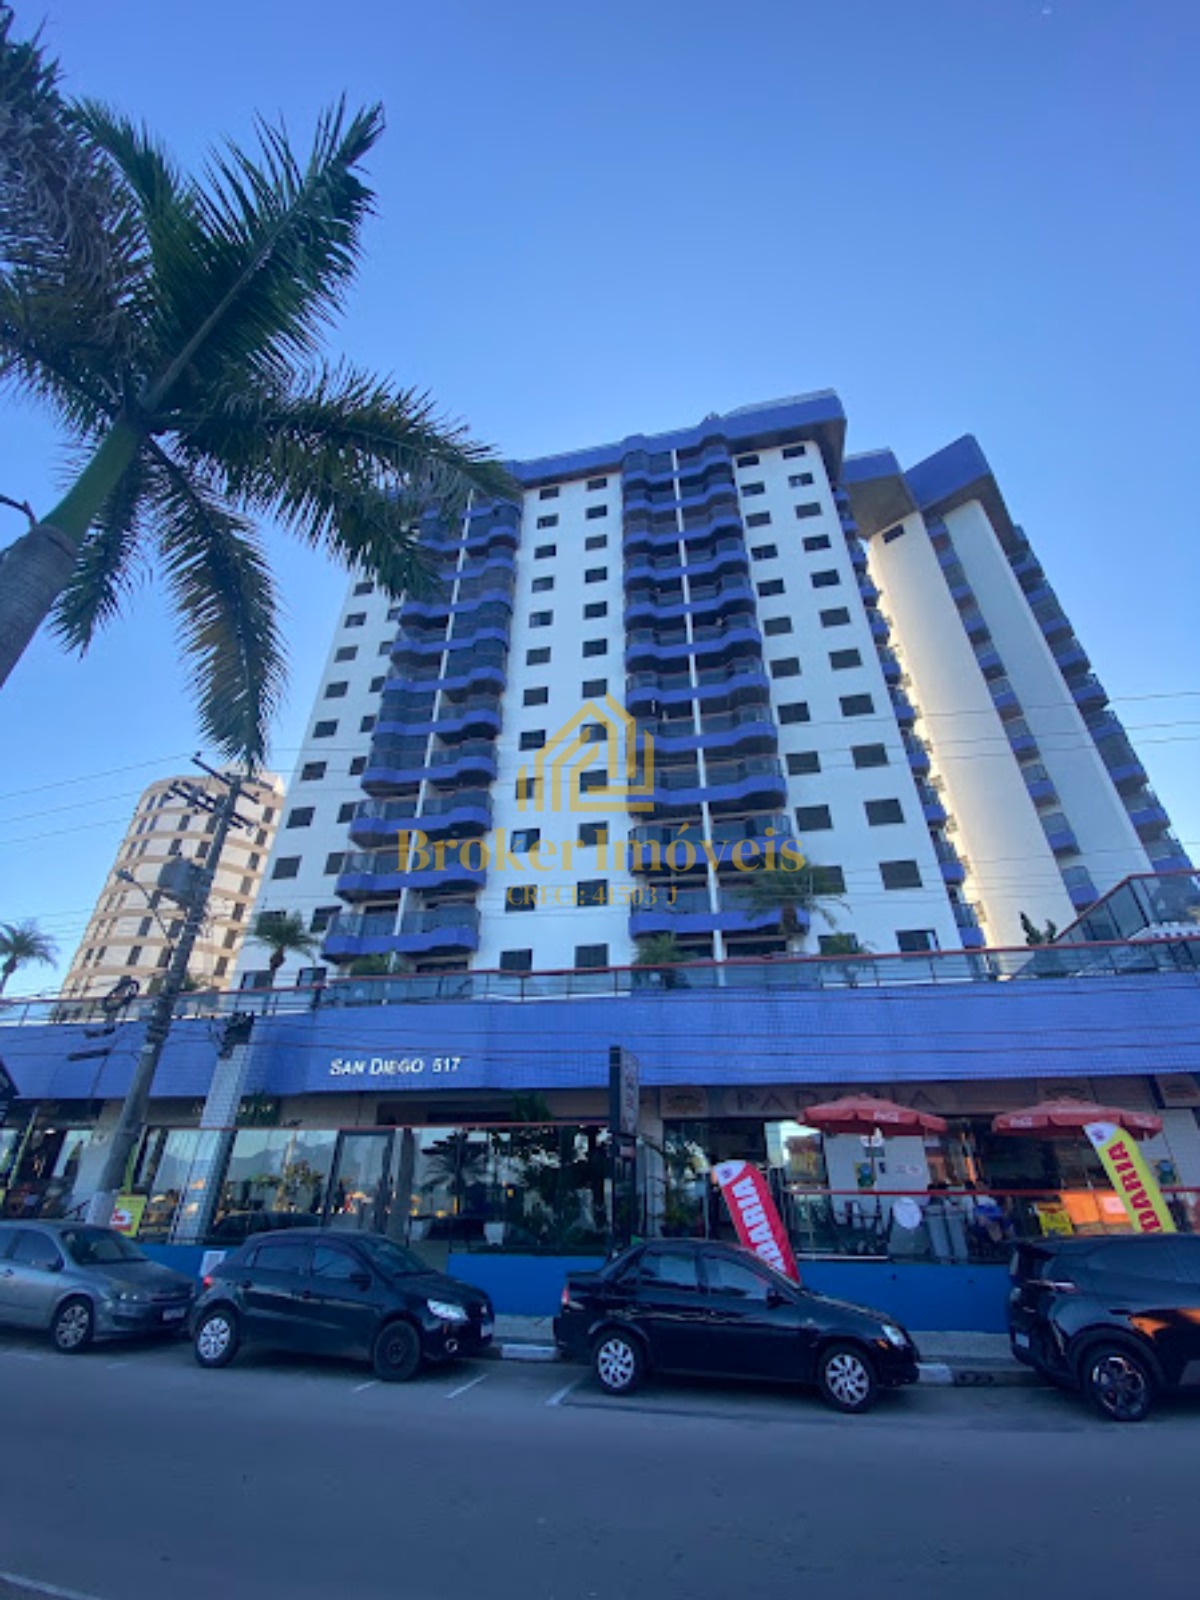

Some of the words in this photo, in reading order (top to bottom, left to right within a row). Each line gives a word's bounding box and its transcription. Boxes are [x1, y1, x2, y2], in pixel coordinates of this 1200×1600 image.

[329, 1058, 367, 1075] SAN
[370, 1057, 425, 1075] DIEGO
[432, 1057, 461, 1073] 517
[736, 1088, 939, 1111] PADIA
